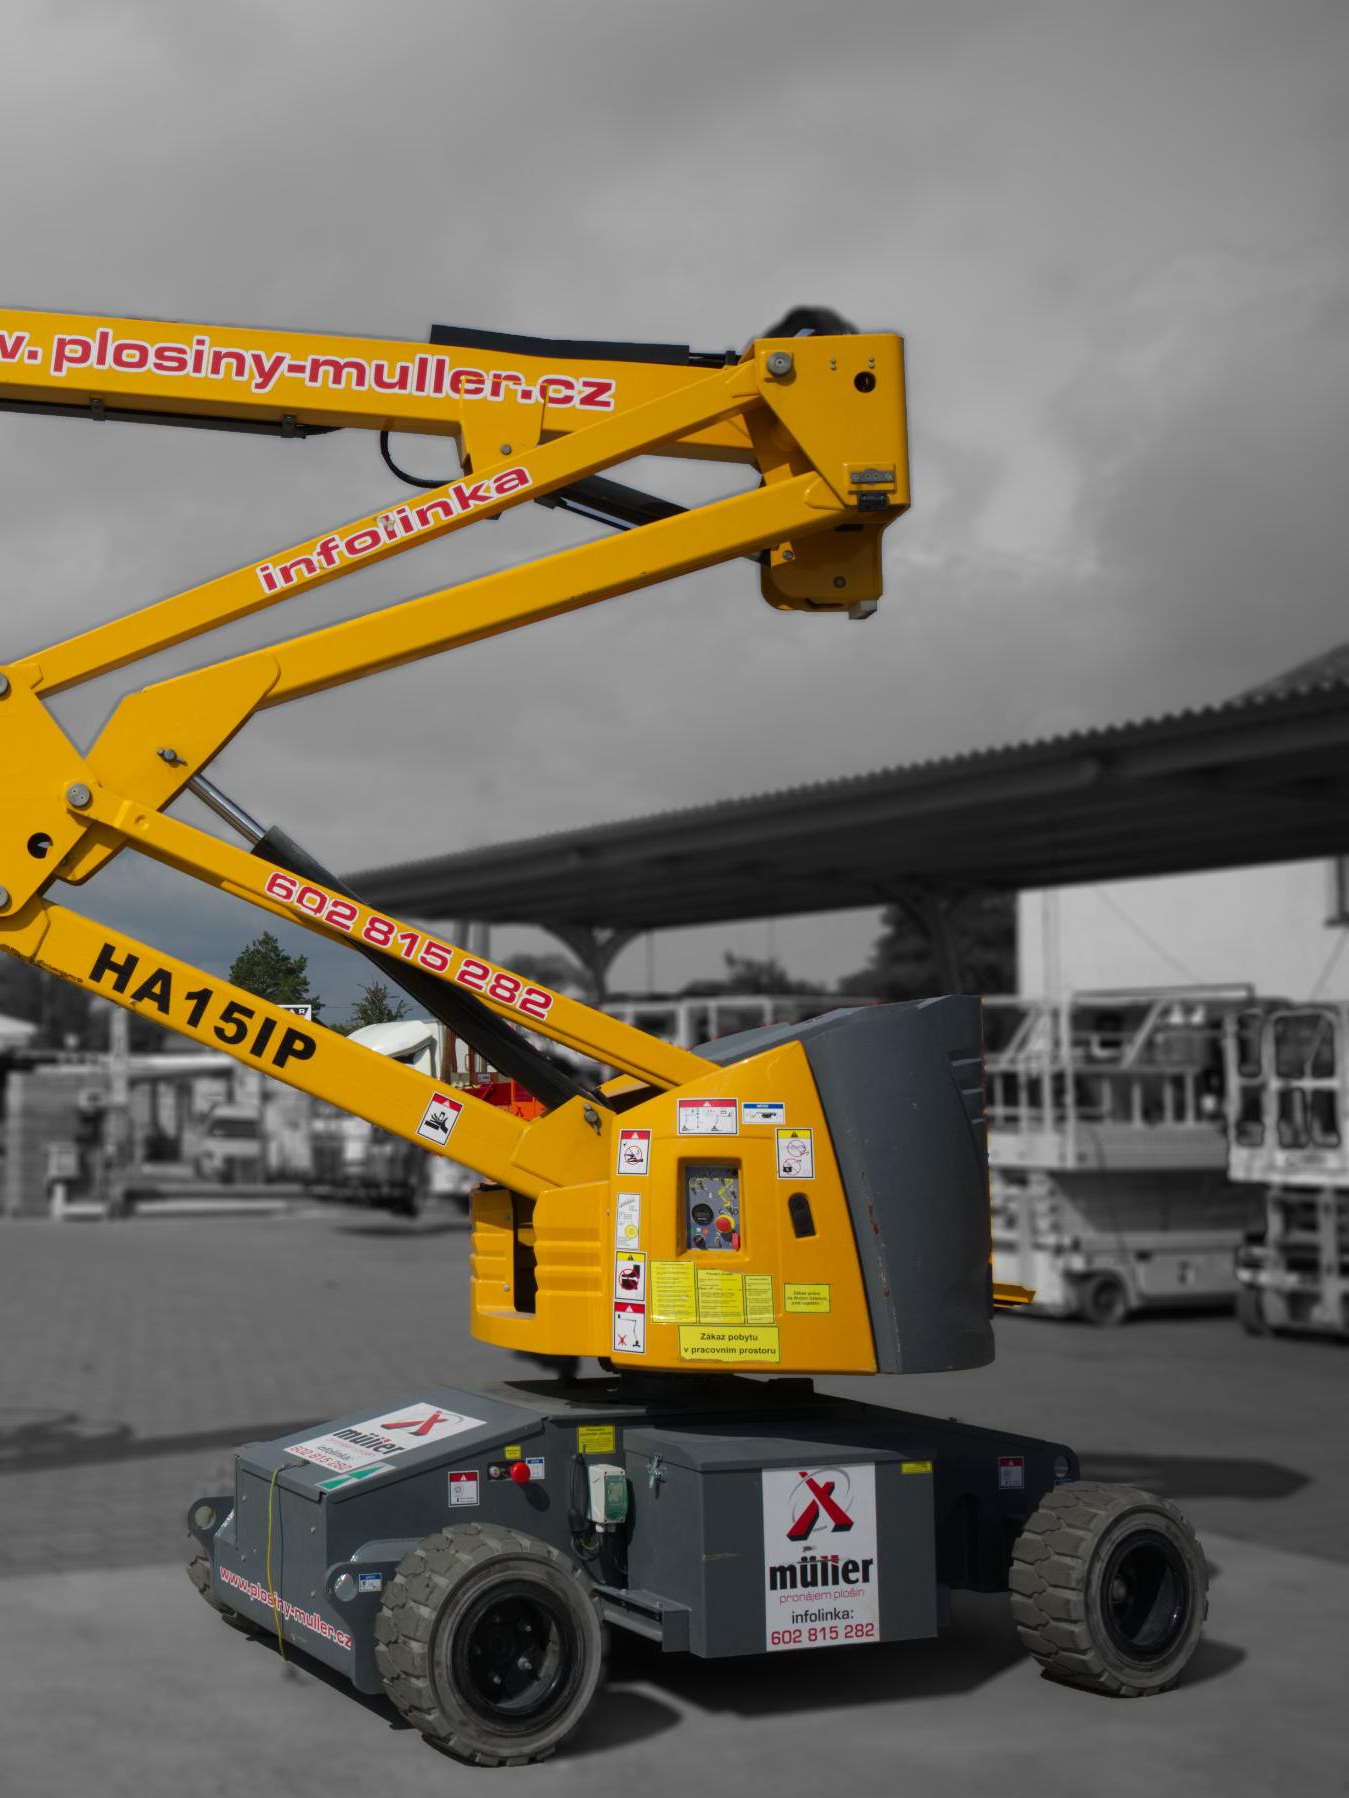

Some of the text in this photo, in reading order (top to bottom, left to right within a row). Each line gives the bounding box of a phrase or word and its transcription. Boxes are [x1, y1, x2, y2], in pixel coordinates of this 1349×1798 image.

[257, 466, 534, 595] infolinka
[265, 872, 554, 1021] 602 815 282
[89, 943, 317, 1069] HA15IP
[728, 1334, 758, 1343] pobytu
[739, 1348, 776, 1356] prostoru
[791, 1608, 855, 1624] infolinka:
[771, 1623, 875, 1646] 602 815 282
